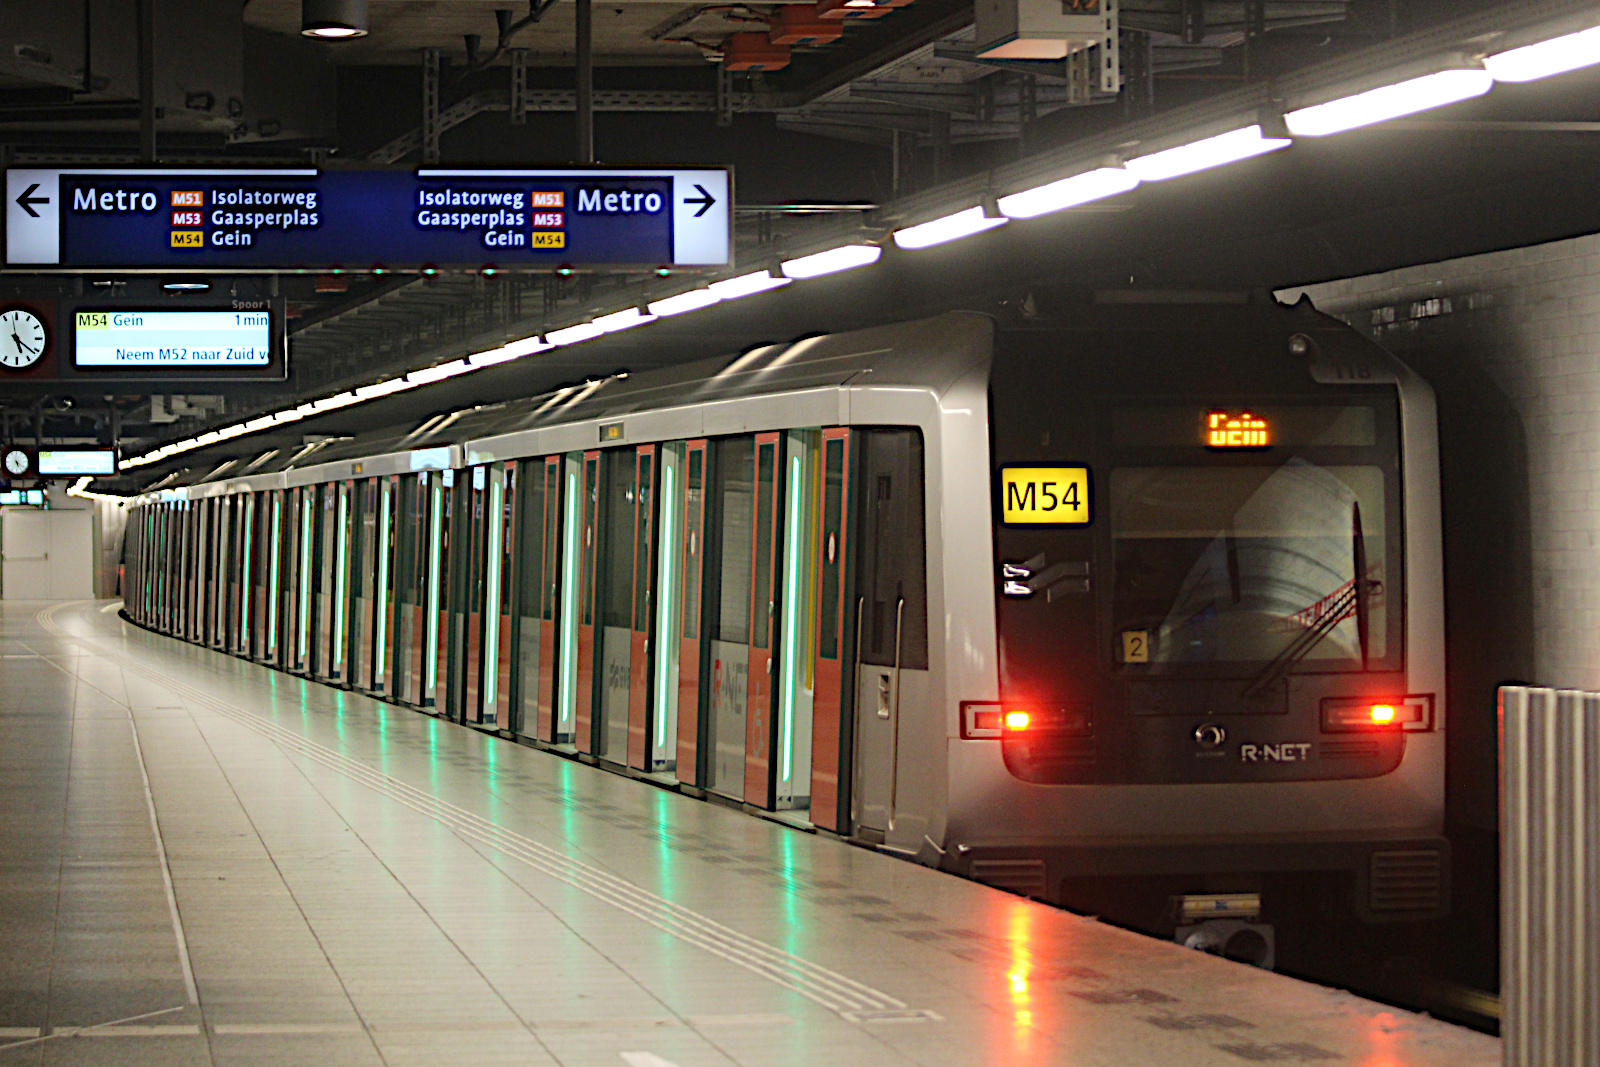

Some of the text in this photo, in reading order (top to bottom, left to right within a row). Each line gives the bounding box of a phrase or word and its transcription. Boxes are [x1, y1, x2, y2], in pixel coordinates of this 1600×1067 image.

[73, 188, 157, 211] Metro
[173, 189, 317, 208] M51 Isolatorweg
[419, 190, 562, 208] Isolatorweg M51
[577, 189, 662, 212] Metro
[173, 210, 318, 229] M53 Gaasperplas
[418, 210, 562, 229] Gaasperplas M53
[173, 230, 252, 246] M54 Gein
[485, 230, 561, 246] Gein M54
[231, 300, 271, 310] Spoor 1
[79, 314, 268, 327] M54 Gein 1 min
[116, 348, 154, 360] Neem
[159, 348, 187, 360] M52
[192, 350, 221, 360] naar
[226, 348, 254, 360] Zuid
[1006, 481, 1081, 511] M54
[1130, 636, 1143, 657] 2
